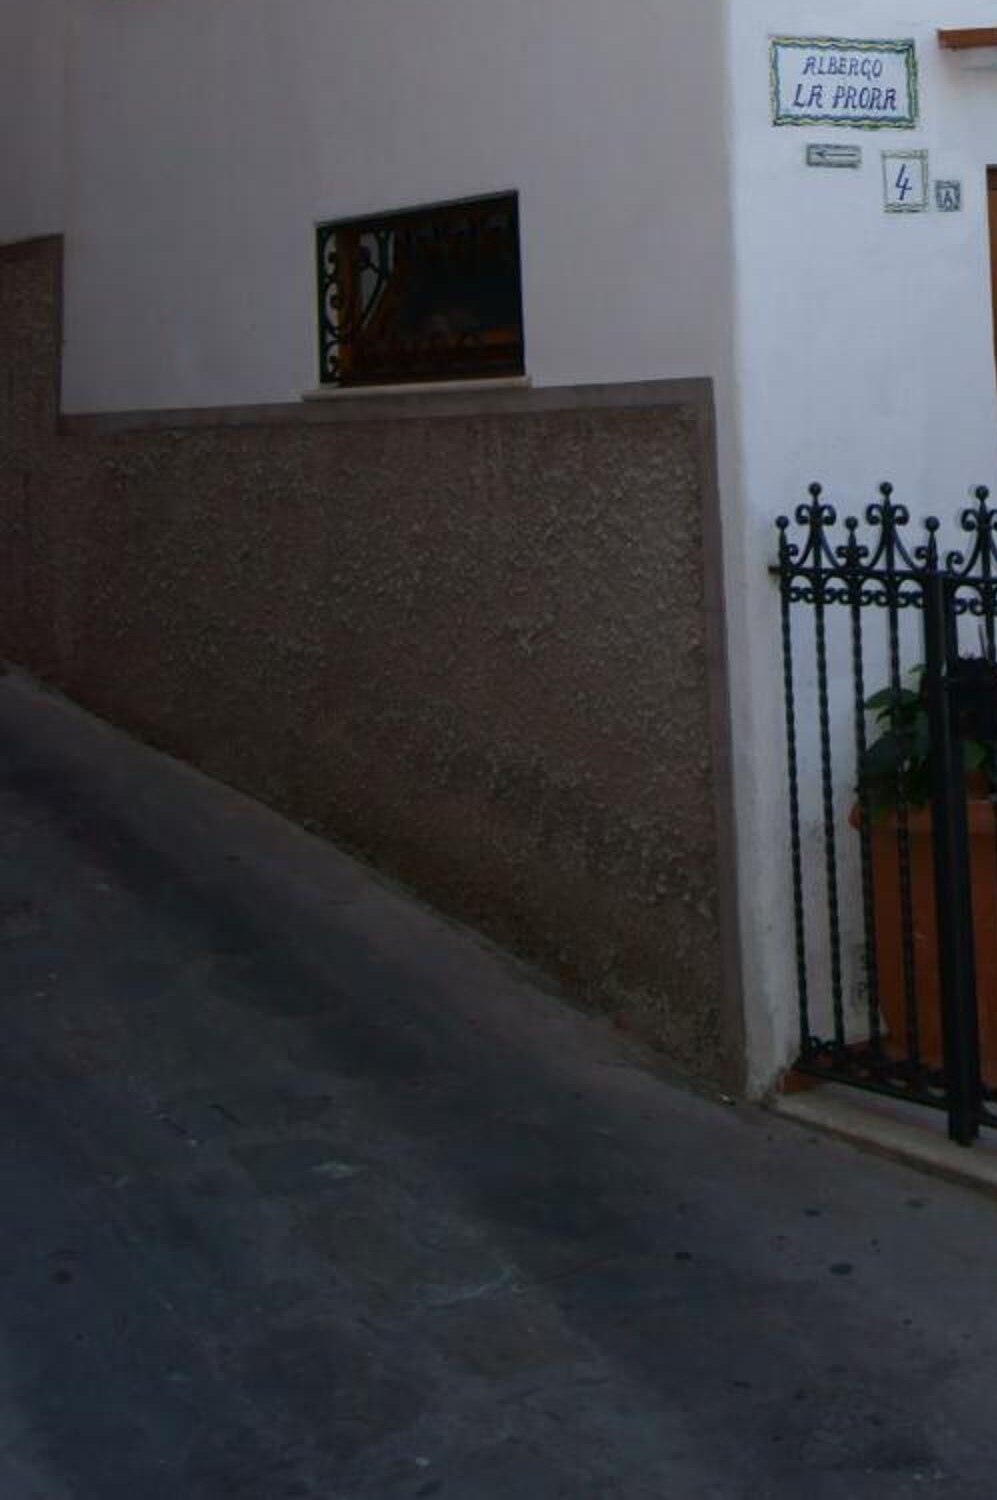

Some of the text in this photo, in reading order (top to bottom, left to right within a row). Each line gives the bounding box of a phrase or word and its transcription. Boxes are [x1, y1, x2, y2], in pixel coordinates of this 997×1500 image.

[802, 55, 883, 82] ALBERGO
[792, 83, 898, 111] LA PRORA
[895, 163, 912, 201] 4
